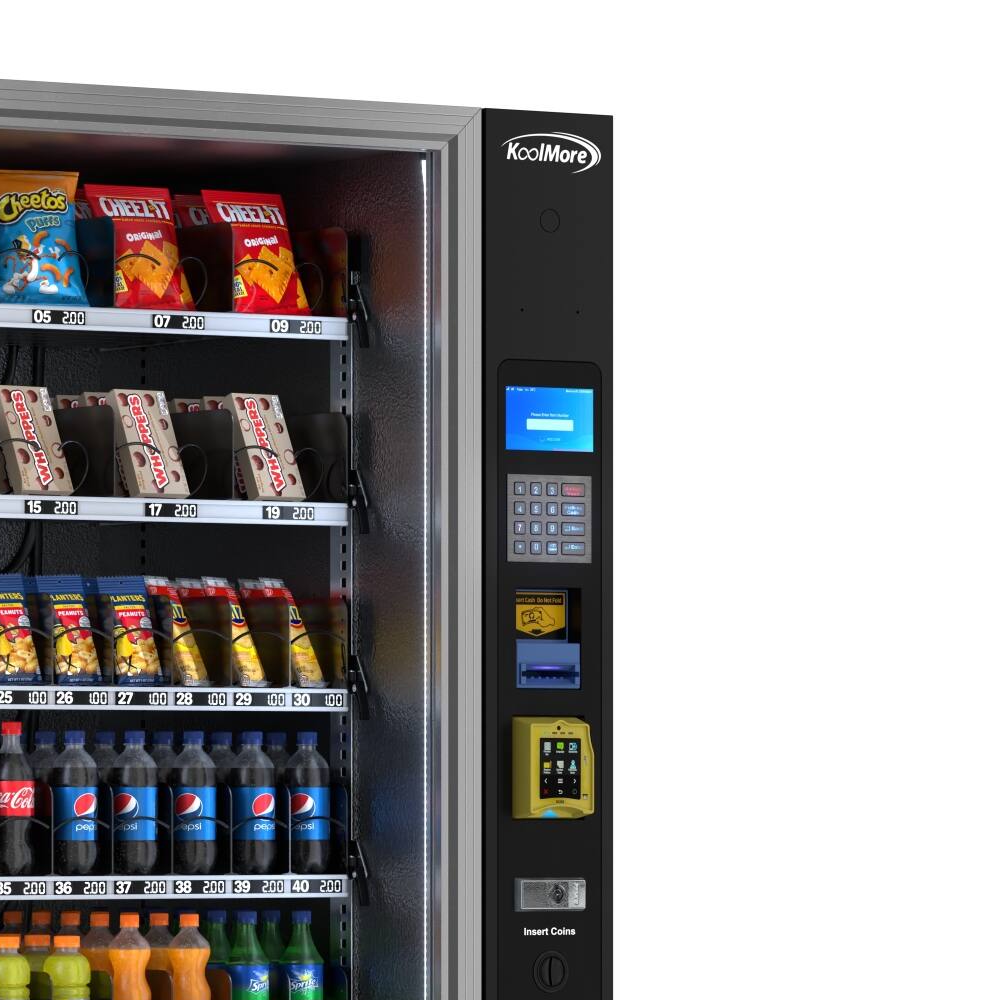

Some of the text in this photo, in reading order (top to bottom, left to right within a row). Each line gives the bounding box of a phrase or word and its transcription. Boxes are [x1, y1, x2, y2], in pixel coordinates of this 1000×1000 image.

[507, 142, 587, 163] KoolMore
[34, 310, 51, 323] 05
[154, 315, 170, 328] 07
[271, 320, 288, 332] 09
[12, 389, 53, 485] WHPPERS
[27, 500, 42, 513] 15
[149, 503, 162, 516] 17
[266, 506, 280, 519] 19
[51, 593, 84, 601] LANTERS
[56, 692, 73, 704] 26
[118, 692, 133, 705] 27
[176, 692, 193, 705] 28
[236, 693, 252, 705] 29
[294, 693, 310, 706] 30
[120, 822, 137, 832] epsi
[254, 822, 275, 832] peps
[55, 882, 72, 894] 36
[116, 881, 131, 894] 37
[175, 881, 192, 893] 38
[234, 881, 250, 893] 39
[292, 880, 309, 892] 40
[523, 926, 576, 936] Insert Coins
